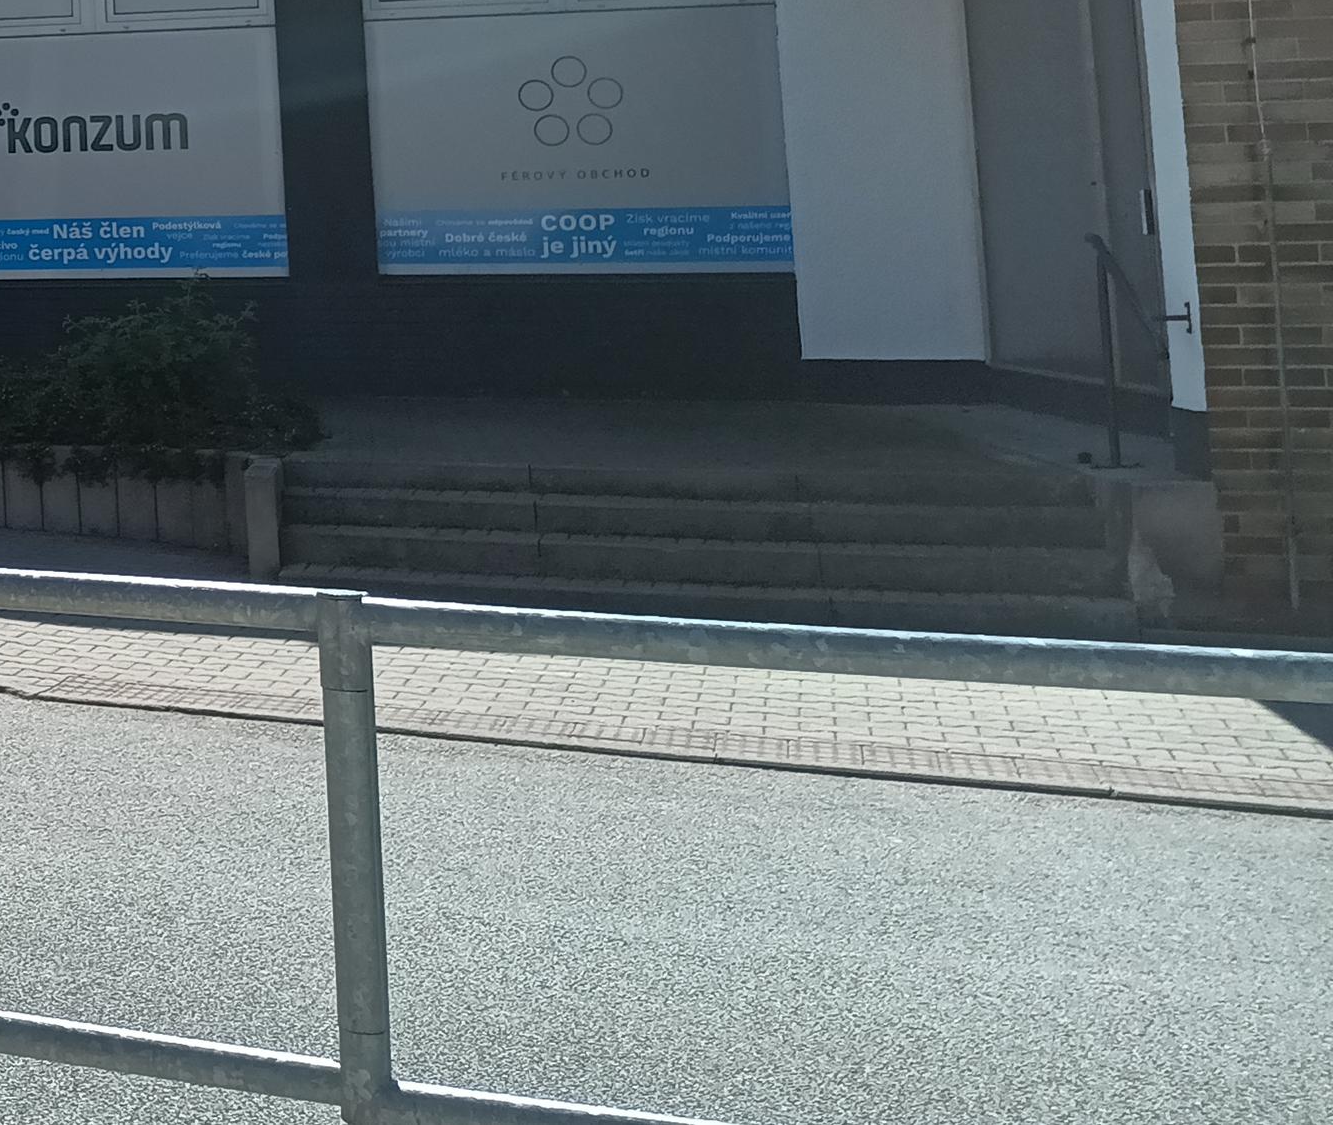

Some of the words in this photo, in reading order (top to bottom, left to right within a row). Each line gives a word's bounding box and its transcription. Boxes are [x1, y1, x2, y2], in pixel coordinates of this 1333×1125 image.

[8, 113, 188, 154] KONZUM
[500, 169, 568, 180] FÉROVÝ
[577, 168, 650, 179] OBCHOD
[541, 214, 615, 231] COOP
[626, 213, 653, 224] Zisk
[657, 213, 710, 224] vracíme
[53, 222, 93, 239] Náš
[99, 221, 145, 239] člen
[644, 225, 694, 237] regionu
[445, 232, 483, 243] Dobré
[488, 231, 527, 242] české
[707, 232, 791, 245] Podporujeme
[28, 243, 89, 264] čerpá
[93, 242, 173, 264] výhody
[439, 247, 478, 257] mléko
[540, 236, 564, 259] je
[569, 235, 617, 258] jiný
[242, 250, 271, 259] české
